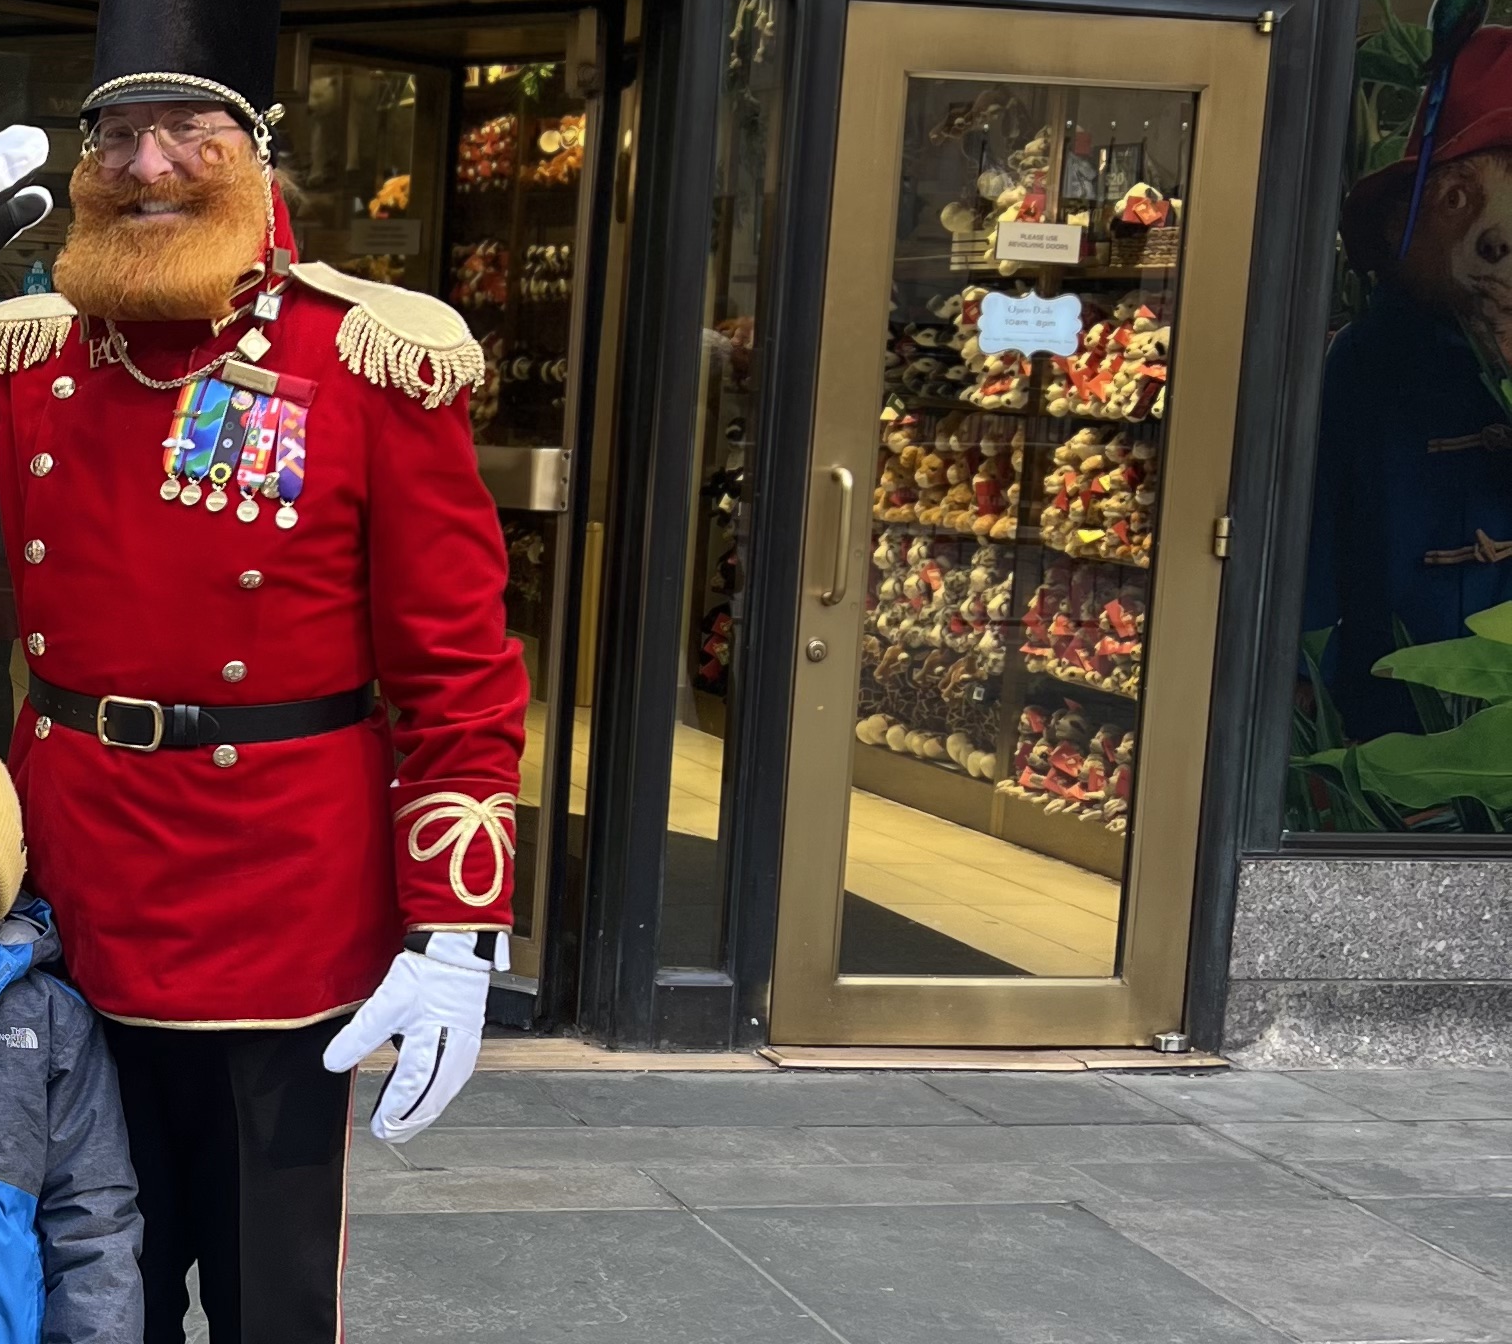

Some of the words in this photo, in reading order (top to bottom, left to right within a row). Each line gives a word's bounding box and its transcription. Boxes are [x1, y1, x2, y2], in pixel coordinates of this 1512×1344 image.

[1020, 233, 1044, 241] PLEASE
[1008, 240, 1045, 249] REVOLVING
[1045, 243, 1069, 251] DOORS
[1004, 318, 1029, 327] 10am
[0, 1033, 26, 1041] NORTH
[7, 1040, 26, 1048] FACE
